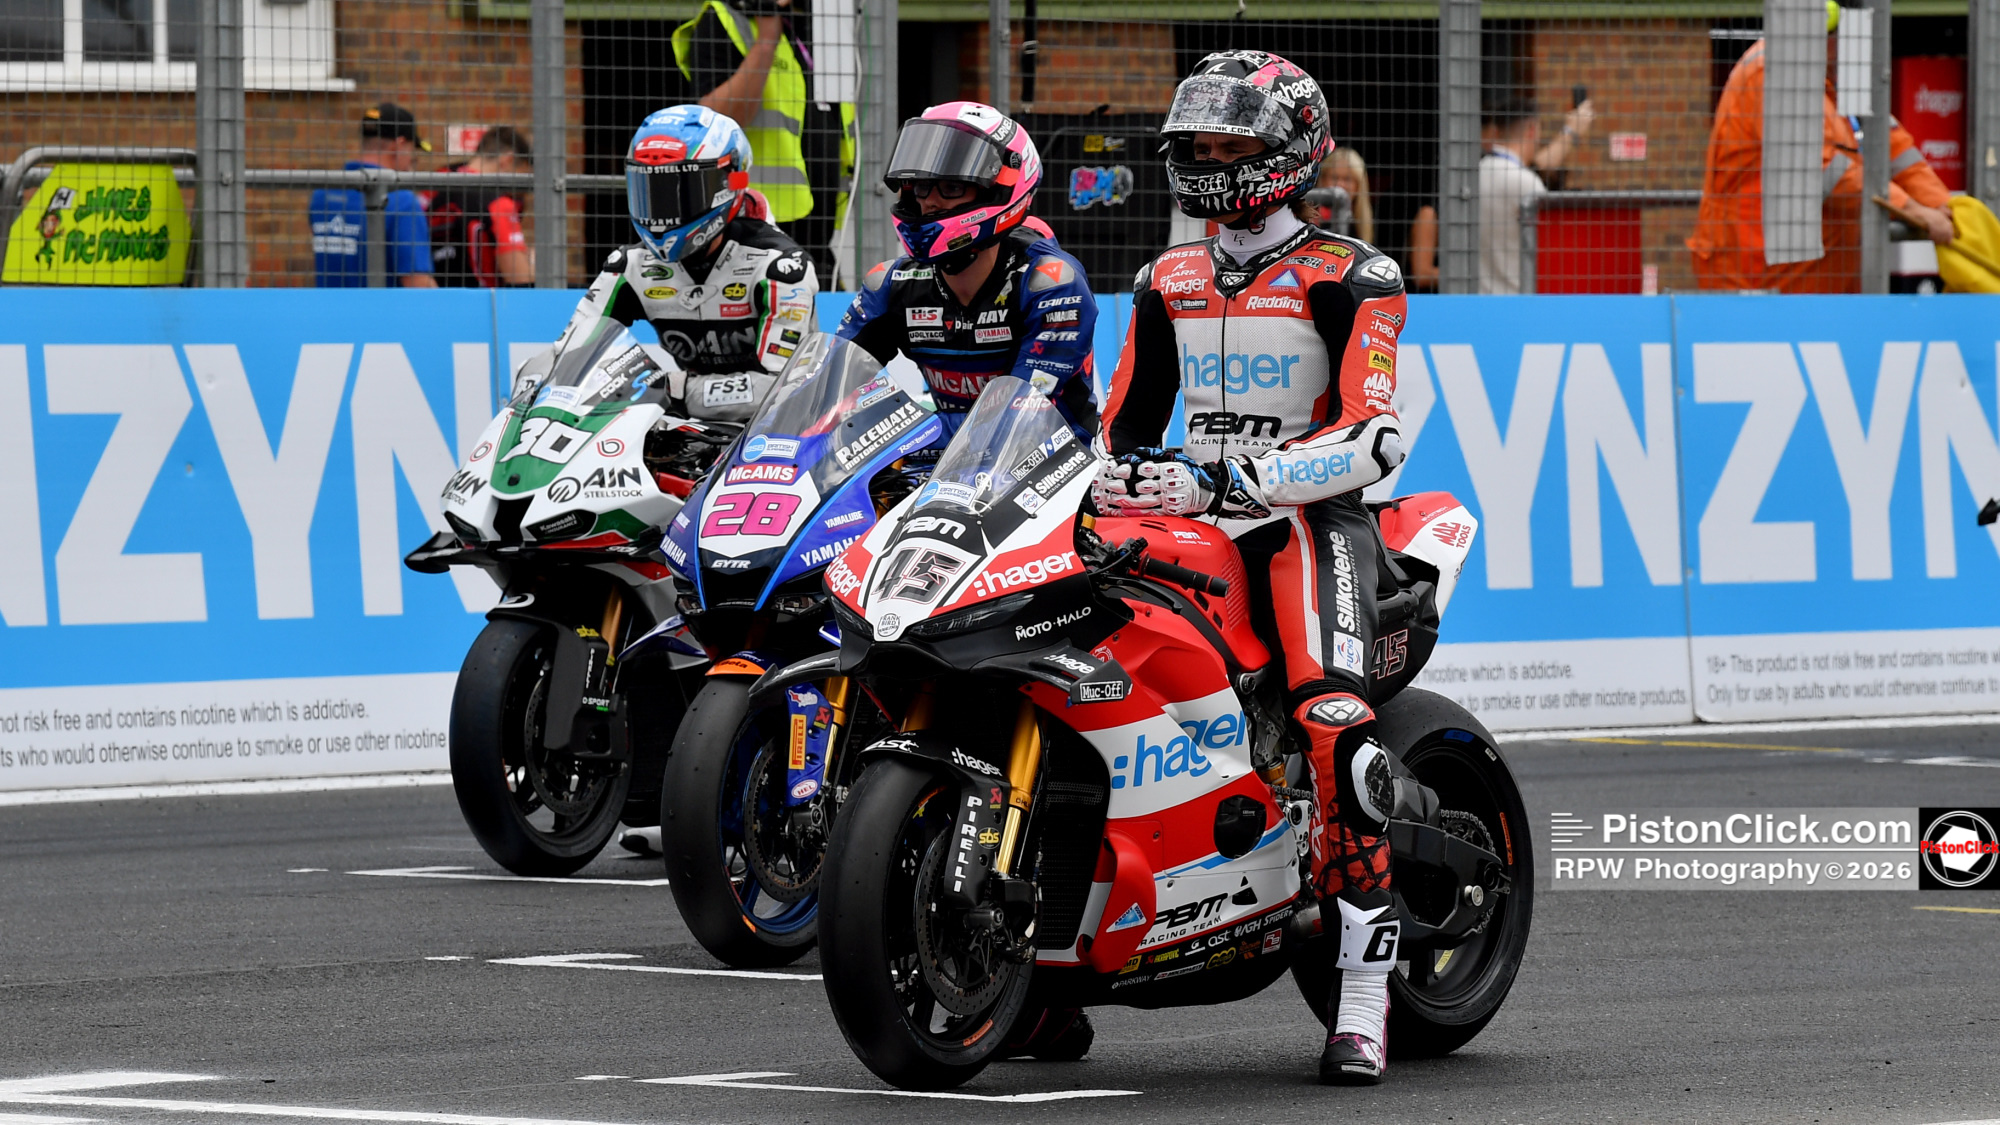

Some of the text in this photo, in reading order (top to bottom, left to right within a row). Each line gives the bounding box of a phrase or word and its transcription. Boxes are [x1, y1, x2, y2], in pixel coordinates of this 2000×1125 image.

[635, 140, 684, 151] LS2
[654, 163, 700, 175] STEEL LTD
[1255, 163, 1314, 198] SHARK
[724, 282, 747, 298] sbs
[1038, 296, 1083, 309] DAINESE
[977, 309, 1009, 325] RAY
[1246, 295, 1304, 313] Redding
[983, 328, 1011, 338] YAMAHA
[1035, 331, 1080, 341] GYTR
[836, 401, 917, 464] RACEWAYS
[1053, 429, 1070, 446] DFDS
[1190, 411, 1282, 439] PBM
[1235, 439, 1273, 448] TEAM
[728, 465, 795, 482] McAMS
[1012, 452, 1045, 480] Muc-Off
[1268, 450, 1356, 486] :hager
[1692, 341, 2000, 585] ZYN
[43, 342, 505, 627] ZYN
[583, 467, 642, 490] AJN
[584, 488, 643, 499] STEELSTOCK
[701, 492, 802, 538] 28
[824, 510, 865, 530] YAMALUBE
[1455, 524, 1472, 549] TOOLS
[660, 534, 687, 568] YAMAHA
[711, 559, 752, 569] GYTR
[973, 550, 1076, 598] :hager
[1043, 653, 1095, 674] :hage
[1346, 637, 1354, 669] FUCHS
[1371, 629, 1408, 680] 45
[1730, 654, 1753, 673] This
[1757, 654, 1797, 676] product
[1801, 654, 1810, 672] is
[1813, 655, 1829, 671] not
[1854, 651, 1875, 669] free
[1878, 651, 1898, 668] and
[1901, 650, 1943, 668] contains
[1946, 648, 1988, 666] nicotine
[1422, 662, 1468, 684] nicotine
[1472, 660, 1505, 681] which
[1509, 660, 1517, 680] is
[1082, 682, 1122, 699] Muc-Off
[1467, 693, 1479, 712] to
[1483, 690, 1521, 711] smoke
[1525, 693, 1537, 709] or
[1540, 692, 1560, 709] use
[1563, 689, 1594, 708] other
[1597, 687, 1636, 707] nicotine
[1707, 683, 1733, 706] Only
[1736, 683, 1750, 700] for
[1754, 684, 1773, 701] use
[1777, 681, 1789, 704] by
[1793, 680, 1825, 699] adults
[1828, 681, 1850, 699] who
[1854, 678, 1884, 697] would
[1888, 678, 1938, 697] otherwise
[1942, 676, 1985, 695] continue
[24, 711, 49, 732] risk
[53, 709, 81, 731] free
[86, 708, 112, 730] and
[117, 706, 176, 728] contains
[181, 703, 236, 726] nicotine
[240, 701, 282, 723] which
[287, 701, 298, 721] is
[303, 699, 369, 721] addictive.
[18, 745, 48, 767] who
[52, 743, 95, 765] would
[99, 740, 168, 763] otherwise
[172, 738, 233, 760] continue
[237, 737, 251, 758] to
[255, 735, 303, 756] smoke
[308, 737, 322, 754] or
[326, 735, 351, 753] use
[355, 730, 390, 751] other
[395, 728, 446, 749] nicotine
[791, 717, 804, 767] PIRELLI
[1111, 710, 1245, 789] :hager
[953, 795, 983, 893] PIRELLI
[979, 828, 1000, 845] sbs
[1140, 915, 1222, 947] RACING TEAM
[1362, 925, 1399, 964] G
